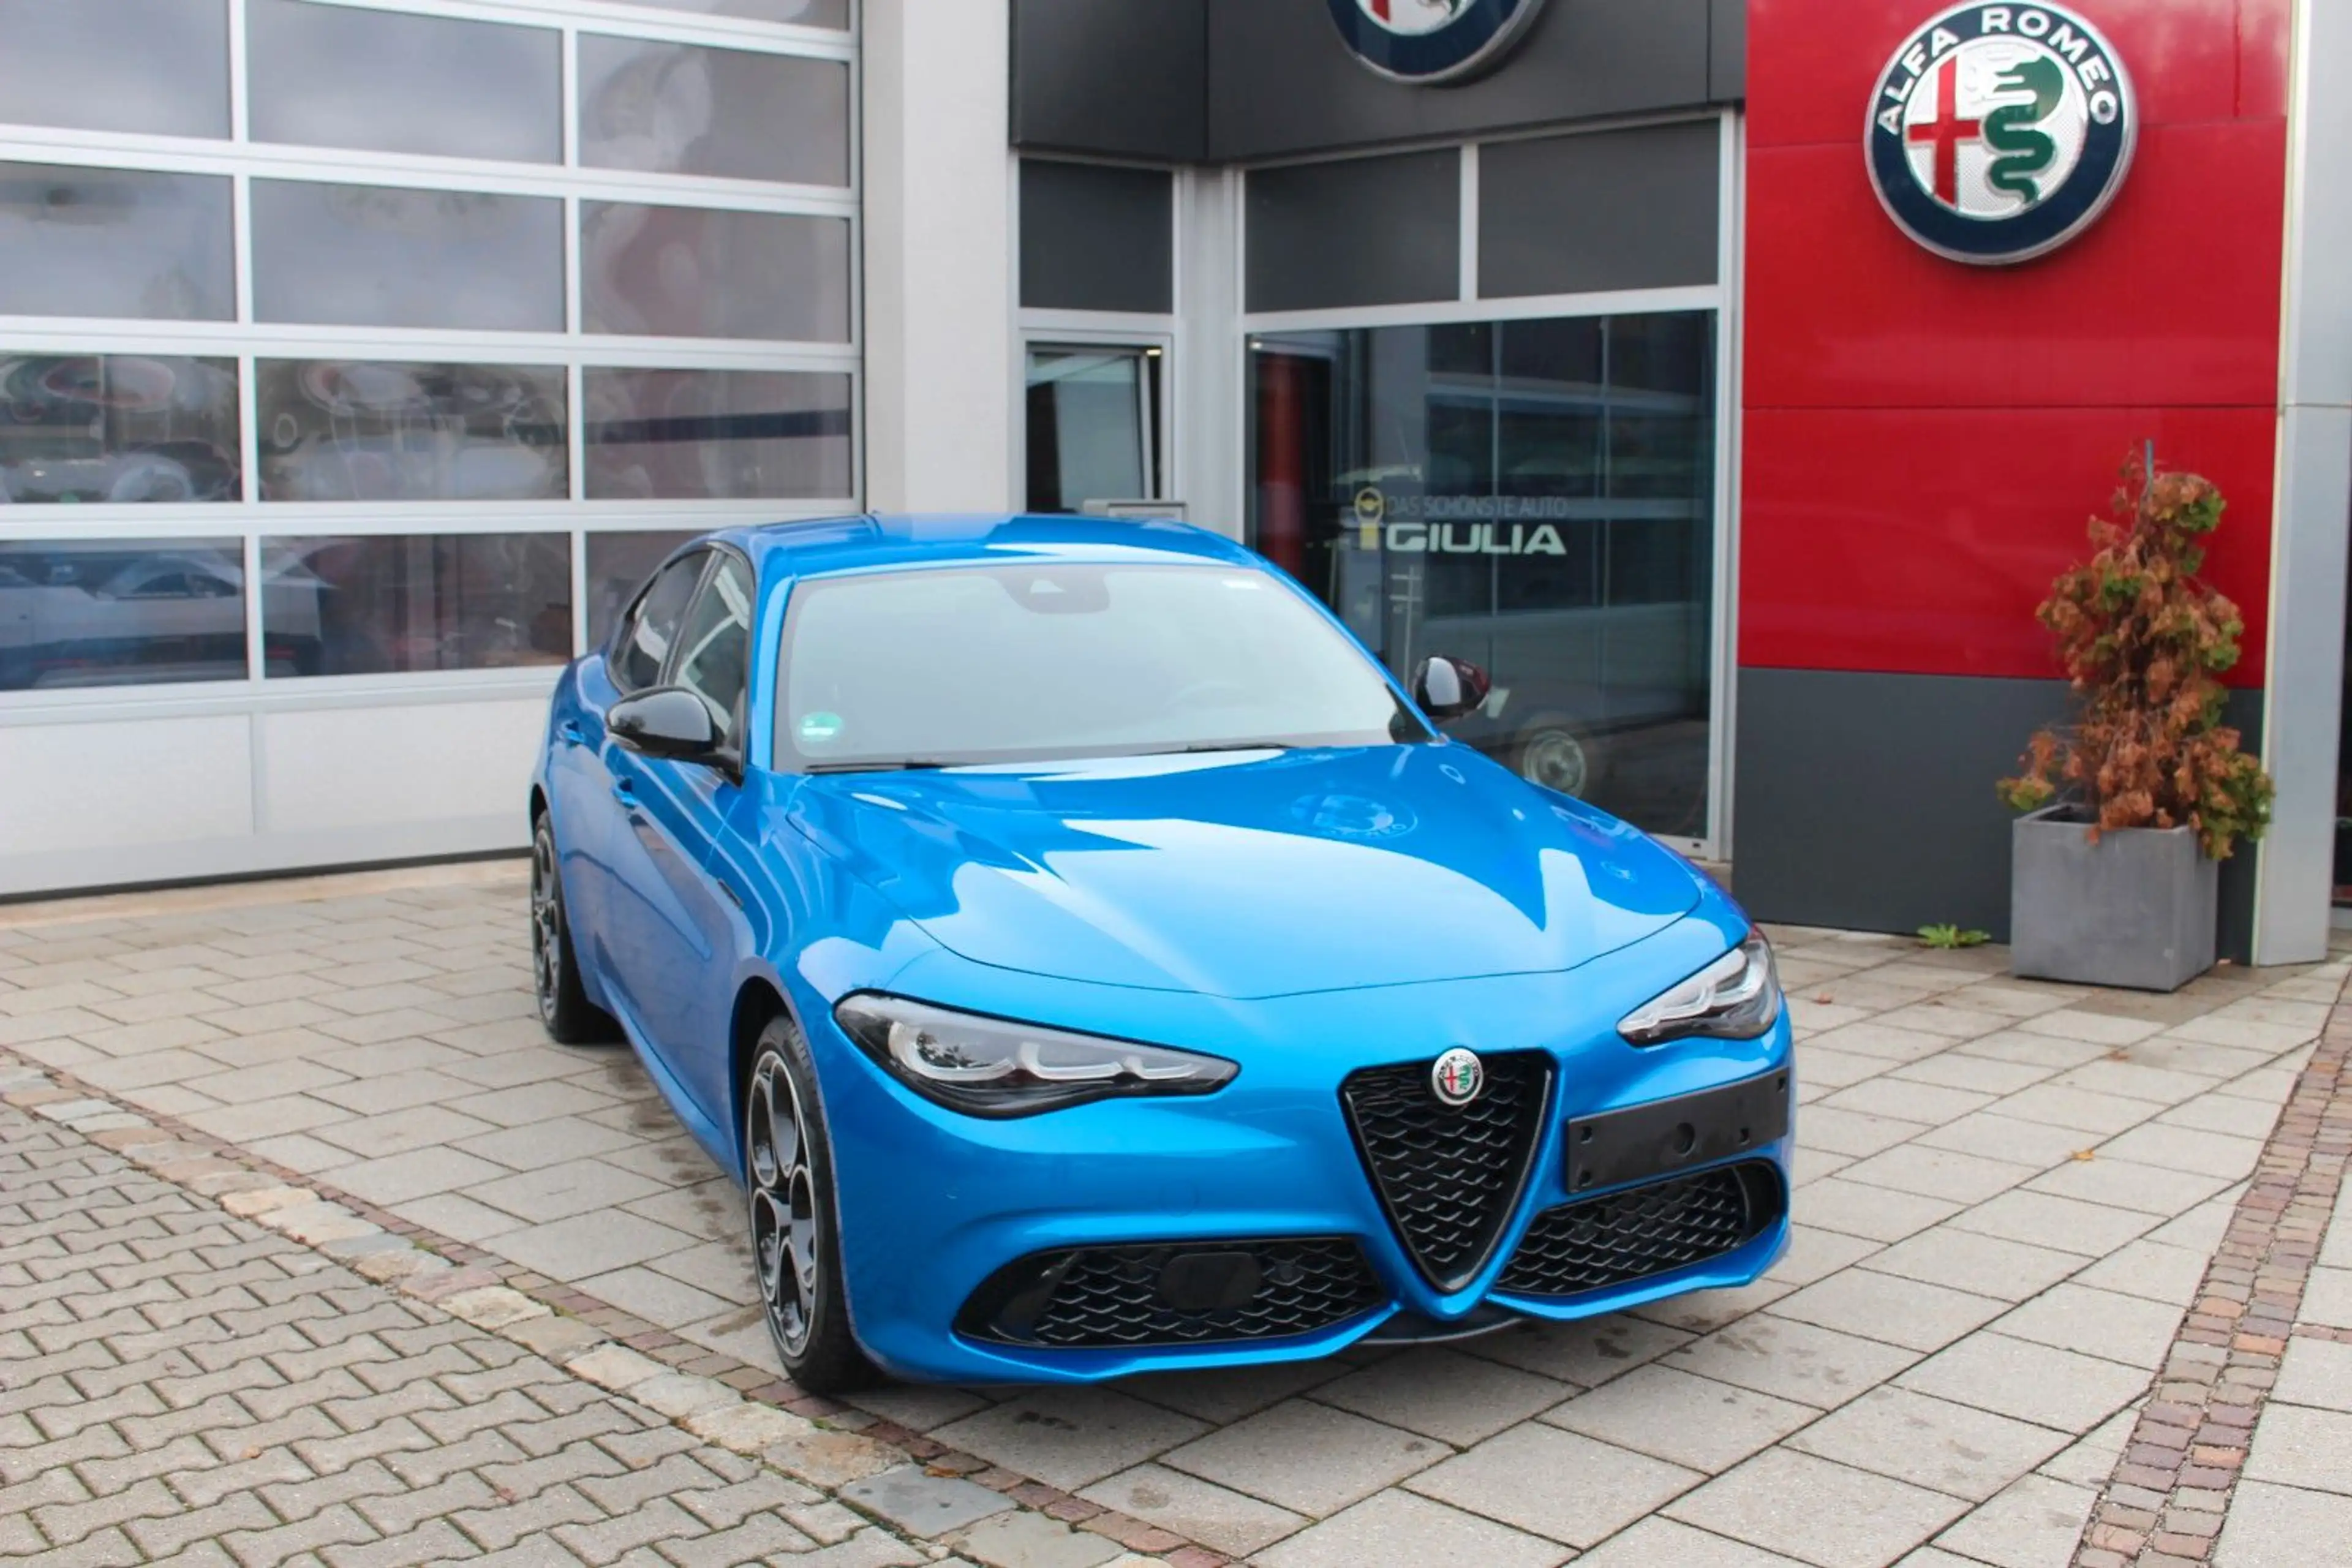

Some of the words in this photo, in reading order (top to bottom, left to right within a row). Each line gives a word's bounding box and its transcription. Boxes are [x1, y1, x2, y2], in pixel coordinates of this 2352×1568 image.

[1877, 27, 1959, 135] ALFA
[1981, 7, 2117, 125] ROMEO
[1387, 496, 1420, 516] DAS
[1518, 496, 1569, 518] AUTO
[1386, 522, 1567, 555] GIULIA
